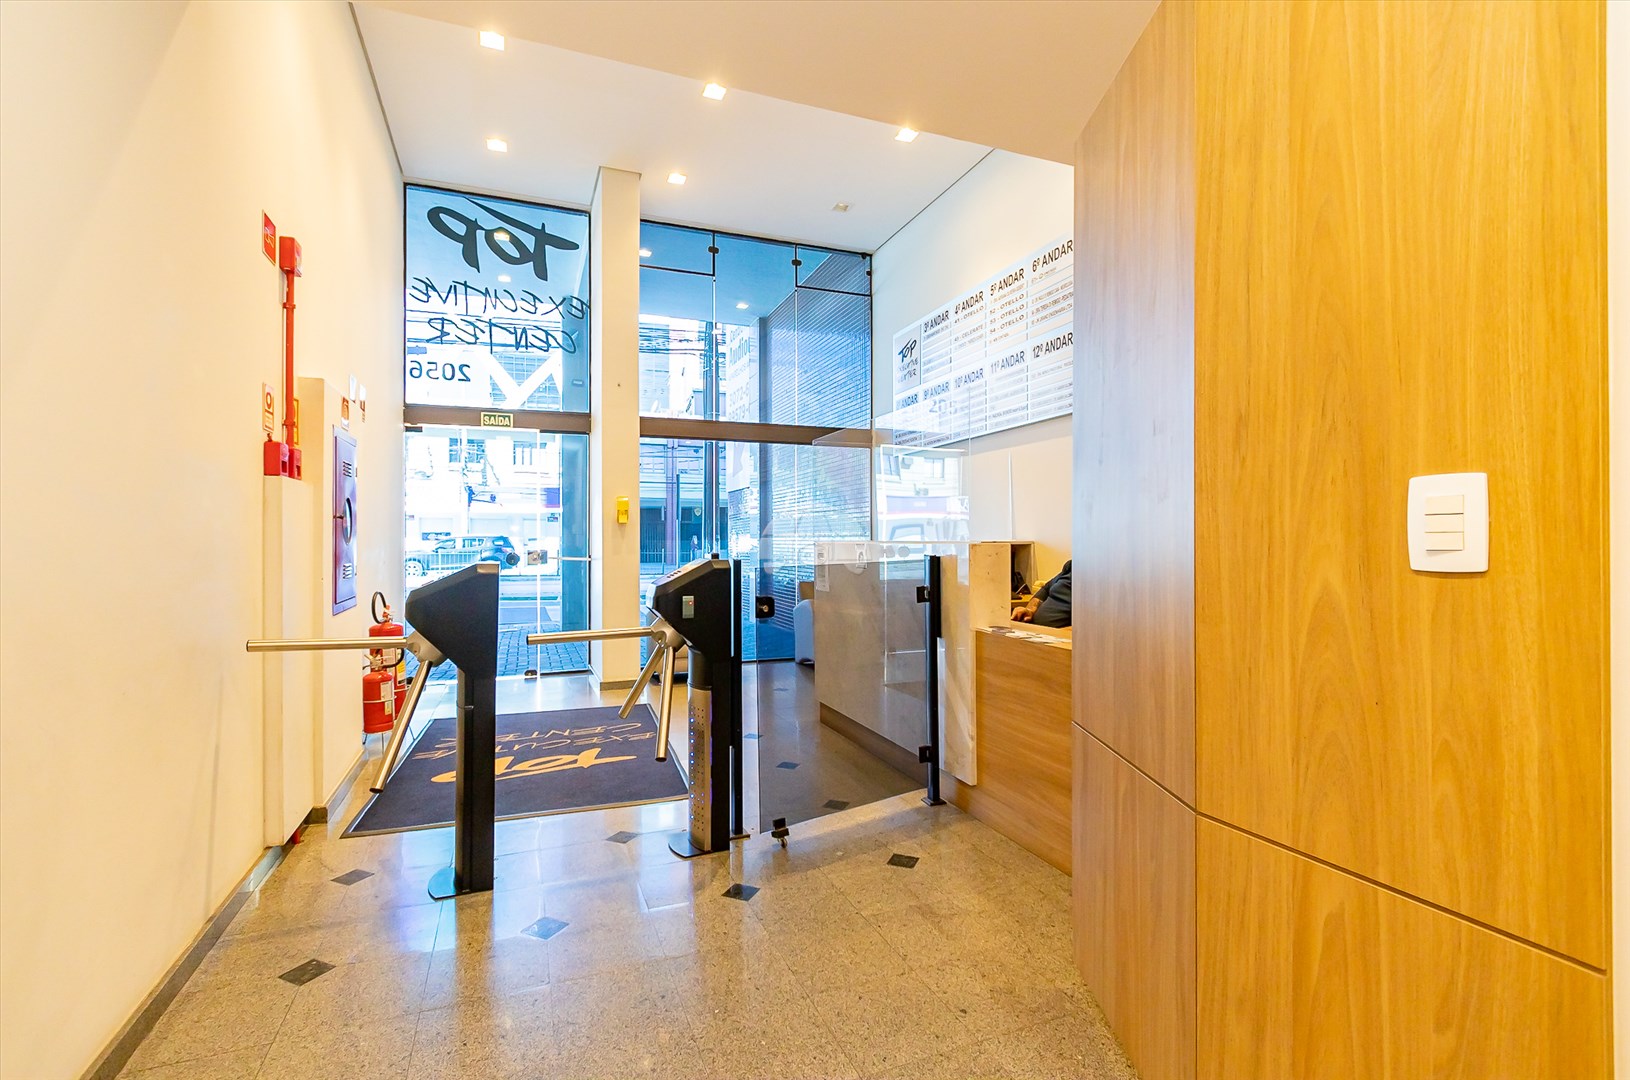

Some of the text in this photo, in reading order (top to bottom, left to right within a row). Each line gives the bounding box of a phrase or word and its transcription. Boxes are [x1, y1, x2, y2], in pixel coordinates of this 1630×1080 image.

[1041, 239, 1073, 268] ANDAR
[998, 268, 1025, 292] ANDAR
[961, 290, 984, 312] ANDAR
[1000, 293, 1025, 310] OTELLO
[930, 310, 949, 330] ANDAR
[963, 305, 984, 320] OTELLO
[1000, 303, 1025, 320] OTELLO
[1000, 314, 1025, 330] OTELLO
[1044, 332, 1073, 355] ANDAR
[1001, 350, 1025, 369] ANDAR
[963, 368, 984, 386] ANDAR
[930, 381, 950, 398] ANDAR
[901, 392, 918, 409] ANDAR
[483, 414, 511, 427] SAÍDA
